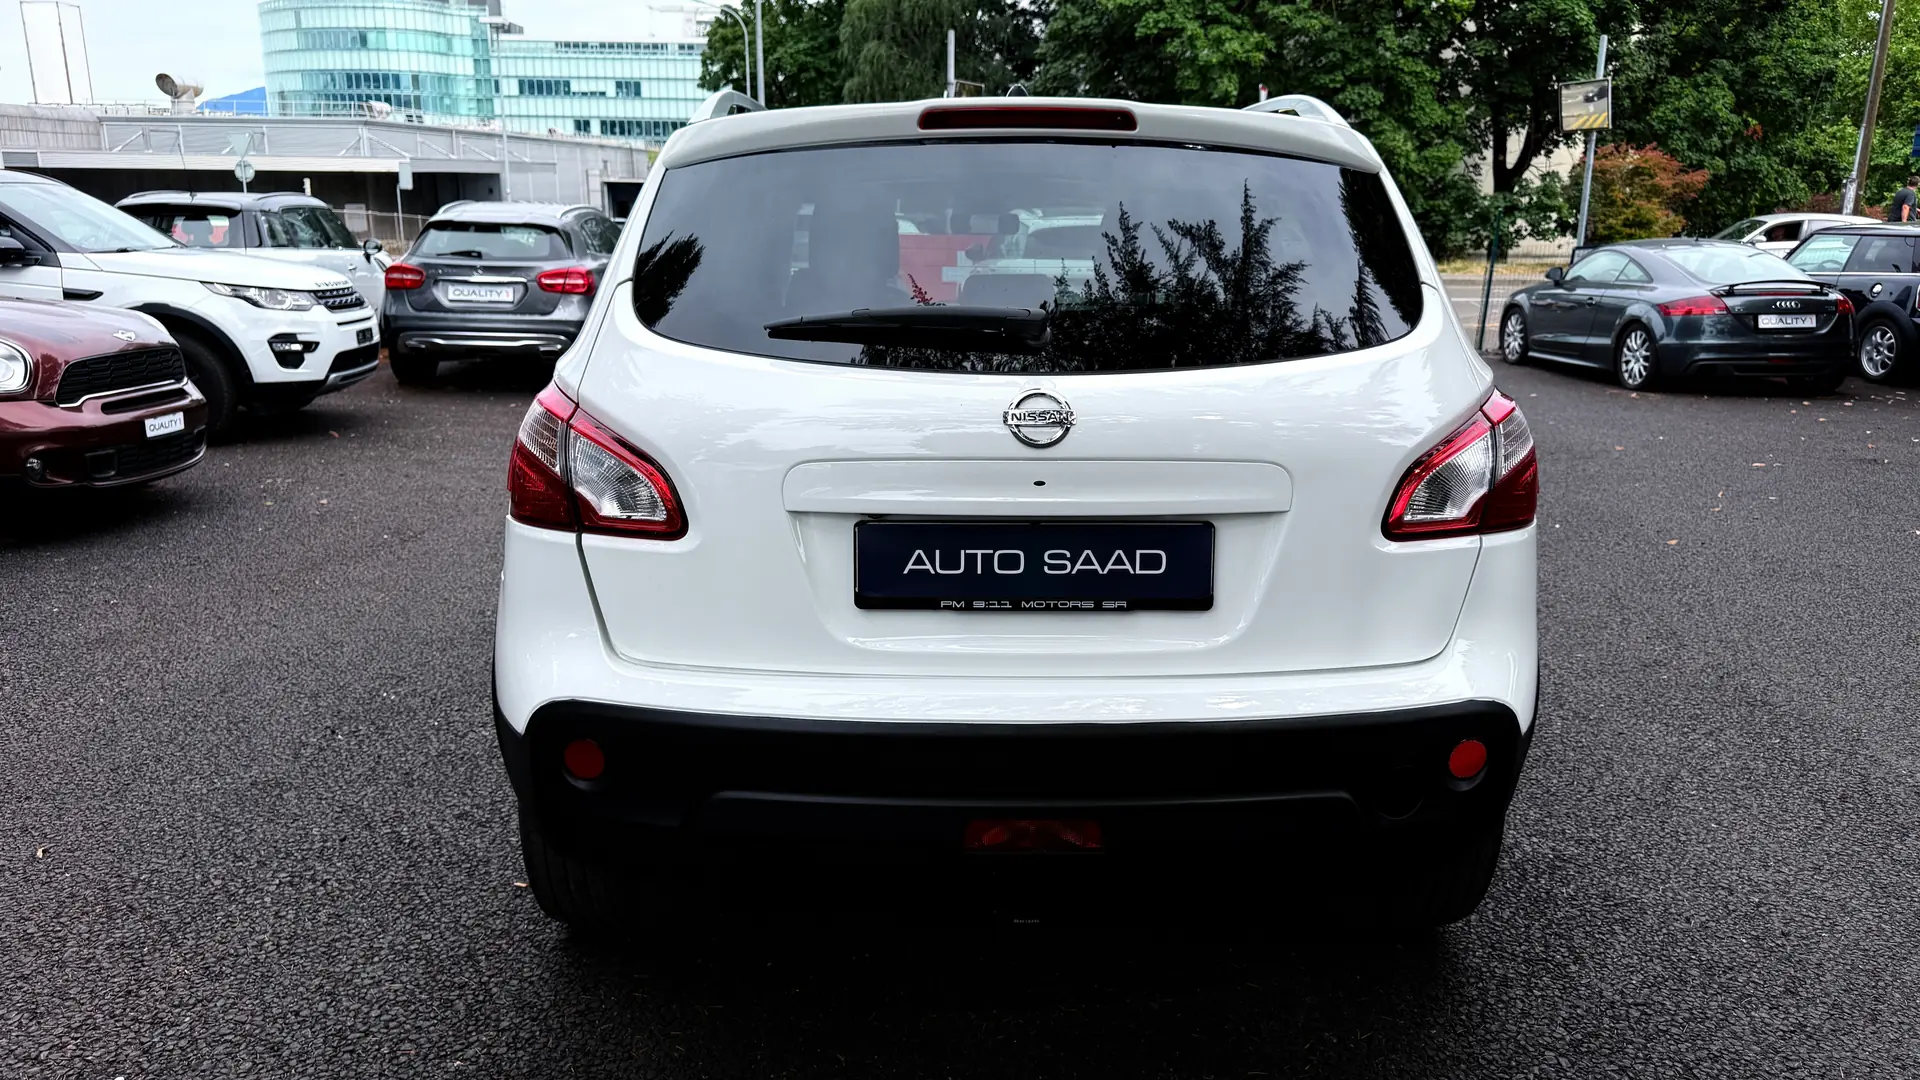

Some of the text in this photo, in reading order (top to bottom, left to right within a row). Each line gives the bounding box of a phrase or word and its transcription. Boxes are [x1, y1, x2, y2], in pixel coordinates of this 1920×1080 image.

[452, 288, 503, 298] QUALITY
[1761, 316, 1807, 325] QUALITY
[1011, 411, 1070, 423] NISSAN
[149, 420, 178, 432] QUALITY
[903, 549, 1167, 575] AUTO SAAD
[940, 600, 965, 608] PM
[973, 600, 1012, 608] 9:11
[1021, 600, 1094, 608] MOTORS
